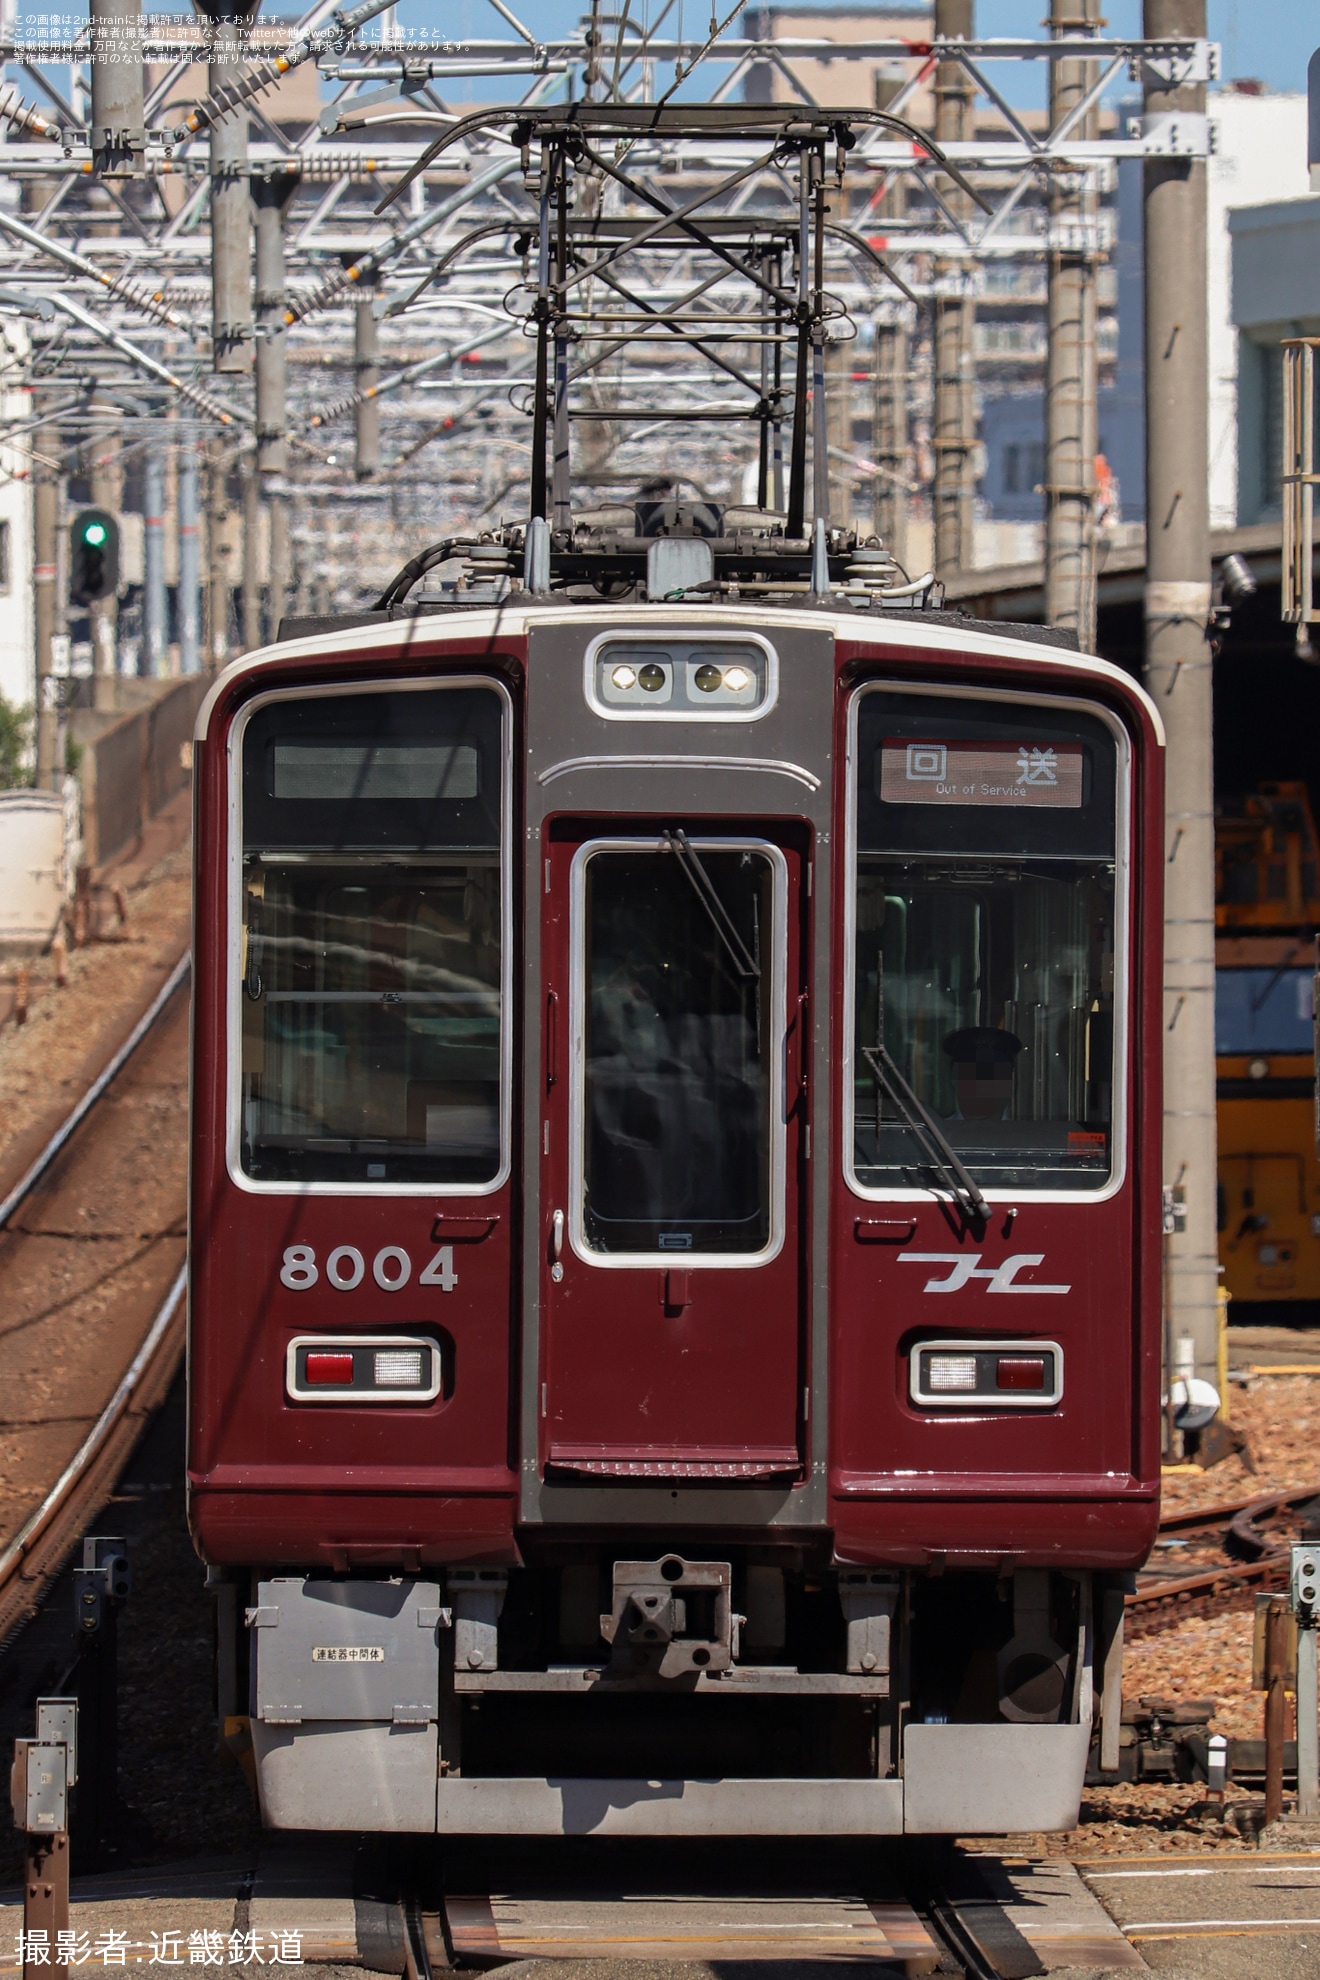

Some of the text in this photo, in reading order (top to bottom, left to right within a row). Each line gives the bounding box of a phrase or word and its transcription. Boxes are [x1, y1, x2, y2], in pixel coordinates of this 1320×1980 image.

[936, 783, 1027, 797] Out of Service
[279, 1244, 458, 1292] 8004
[317, 1648, 380, 1661] 連結器中間体
[52, 1732, 58, 1740] S
[41, 1774, 48, 1783] R
